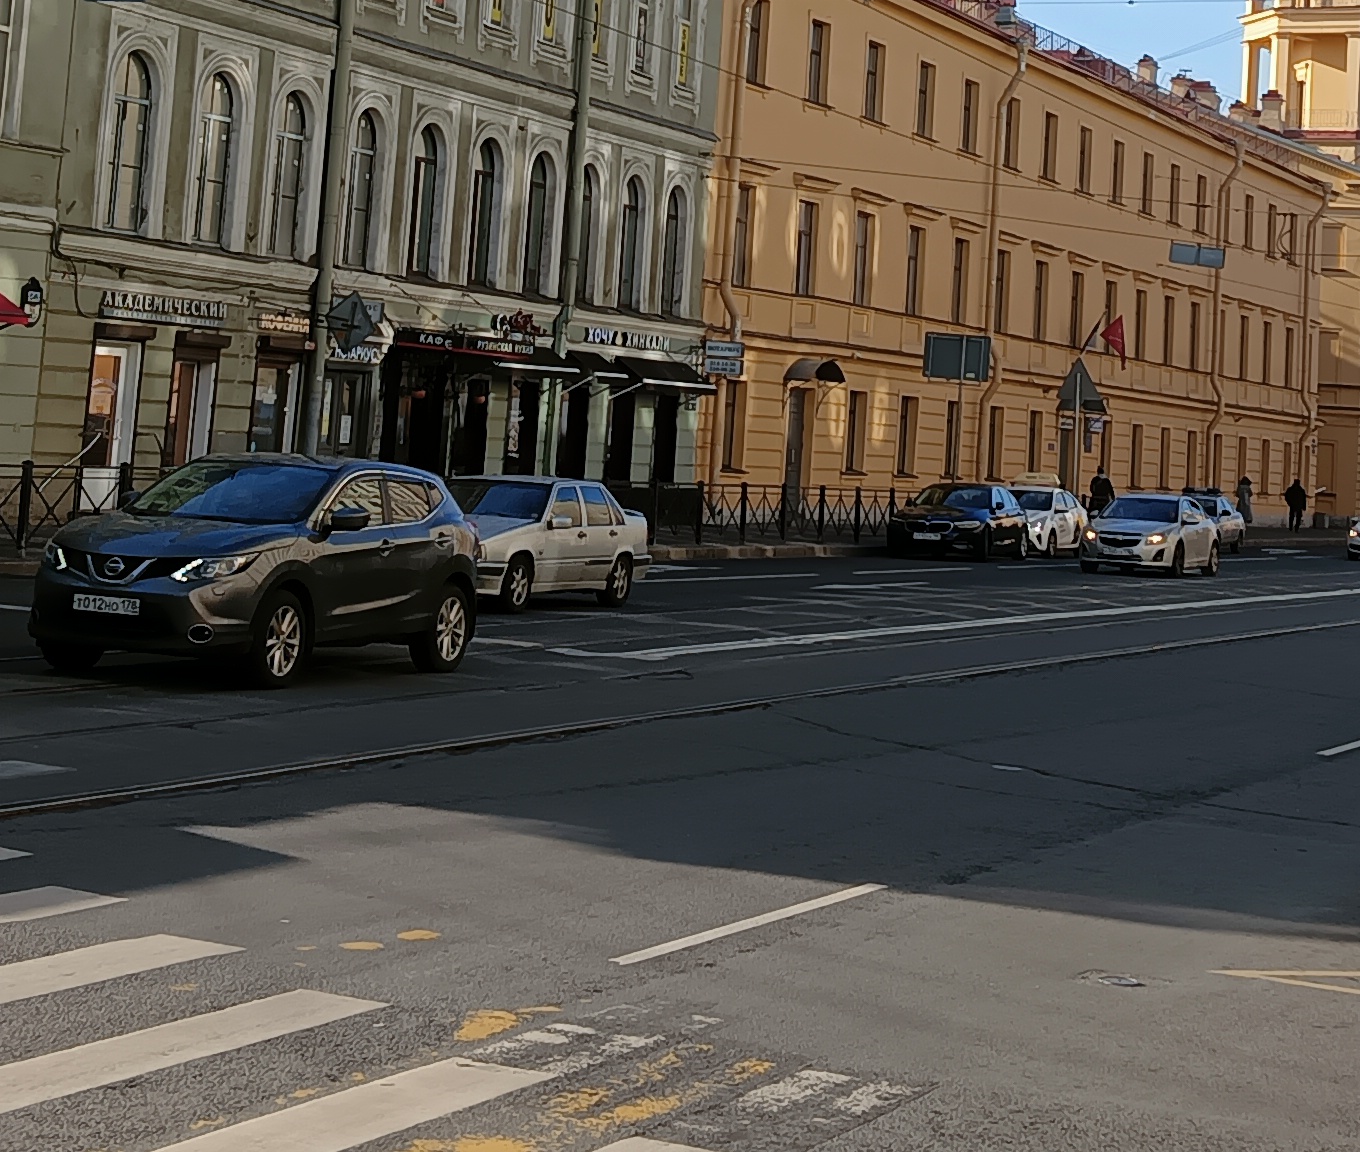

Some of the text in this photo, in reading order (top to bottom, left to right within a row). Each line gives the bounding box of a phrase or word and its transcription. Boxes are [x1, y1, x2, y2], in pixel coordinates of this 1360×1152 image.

[419, 333, 453, 350] КАФЕ
[587, 326, 670, 351] ХОЧУ ХИНКАЛИ
